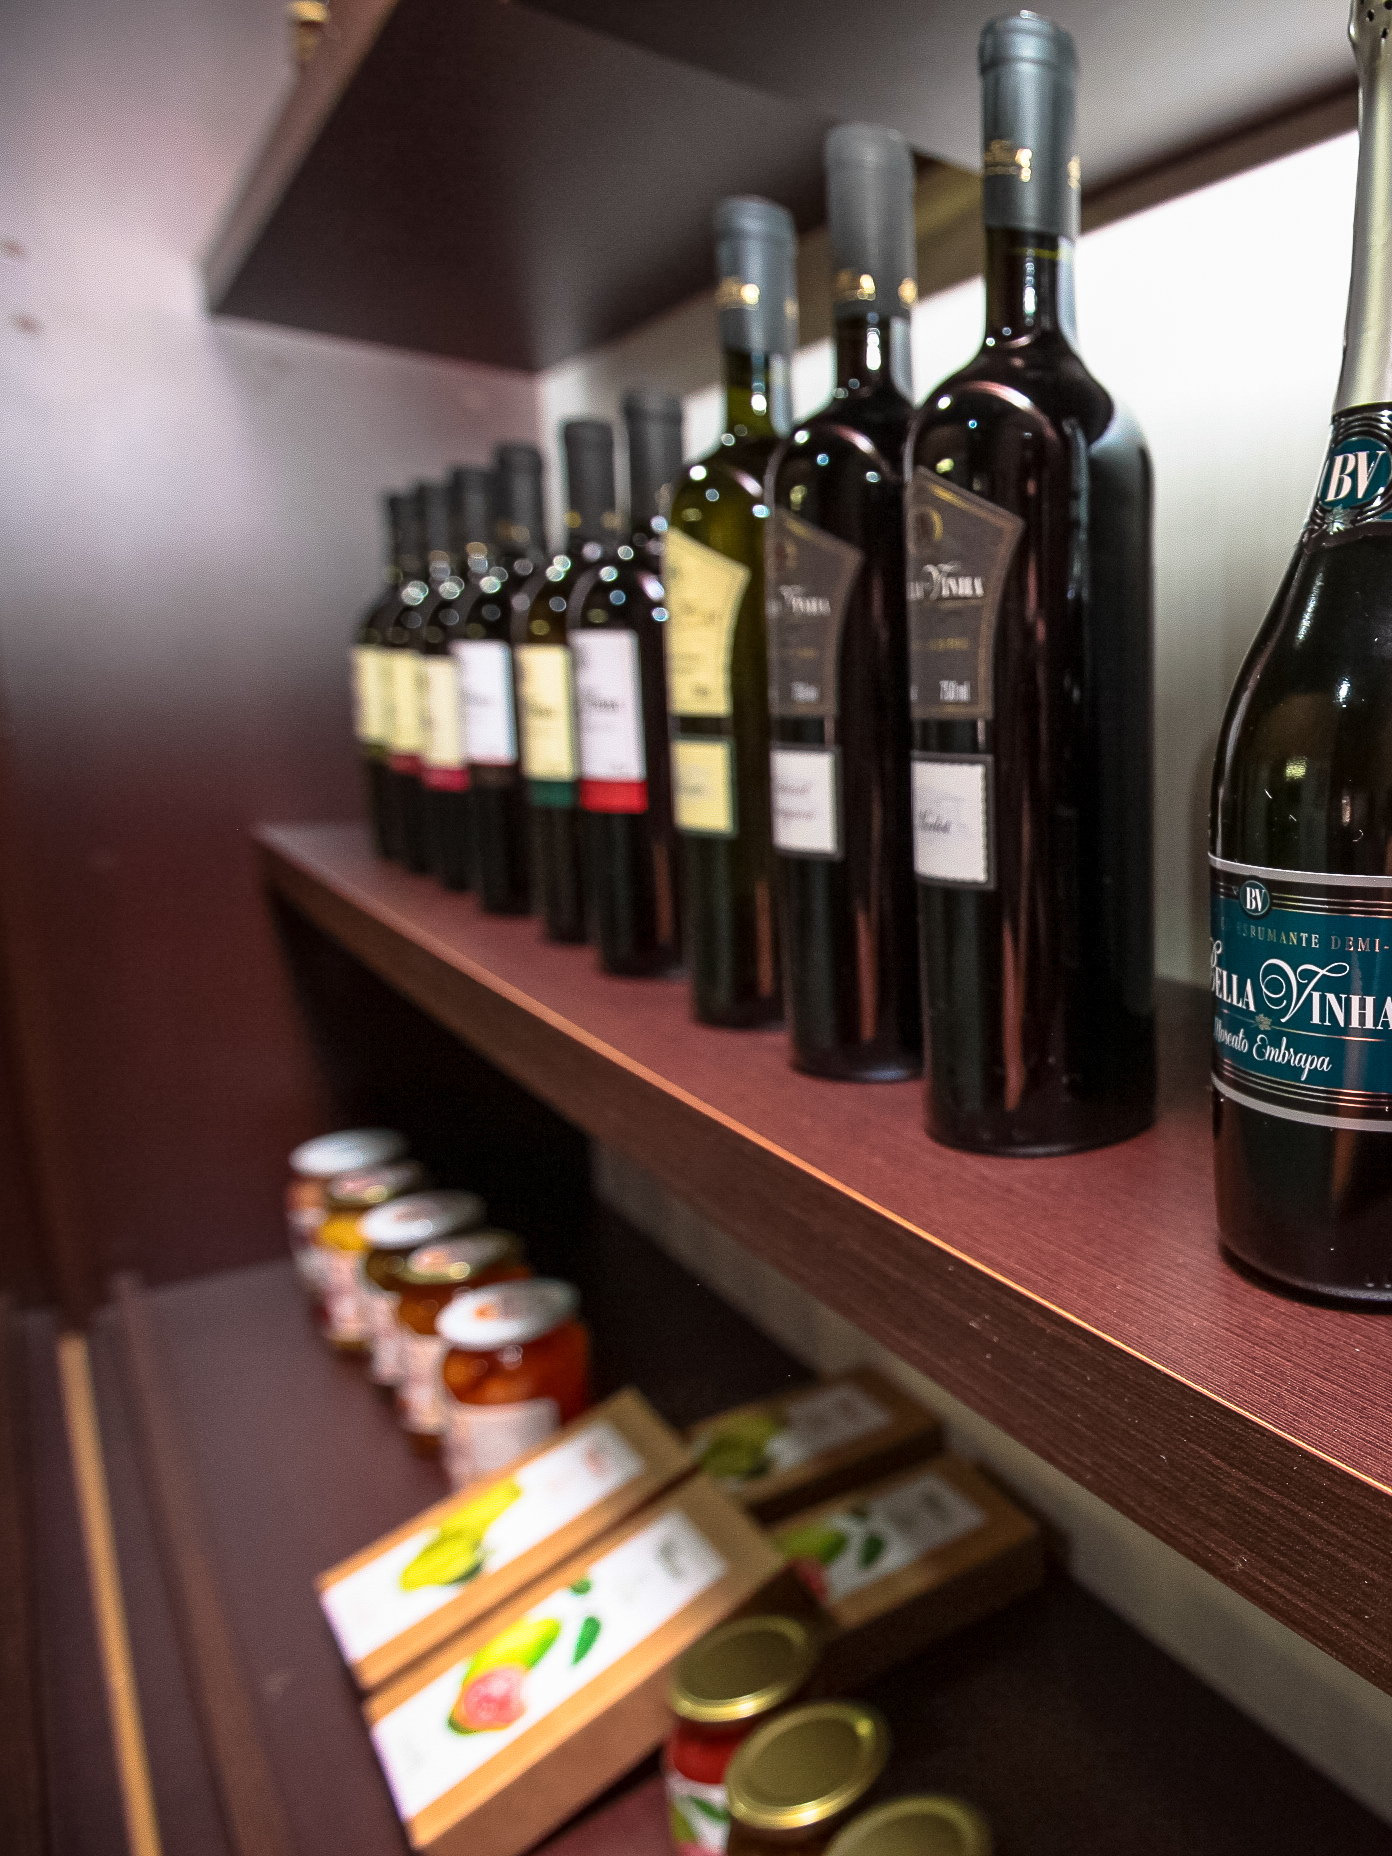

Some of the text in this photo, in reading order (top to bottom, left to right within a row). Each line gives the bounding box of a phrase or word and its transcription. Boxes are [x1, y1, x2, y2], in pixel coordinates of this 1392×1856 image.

[1324, 450, 1387, 502] BV
[1245, 886, 1265, 912] BV
[1252, 1034, 1333, 1081] Embrapa
